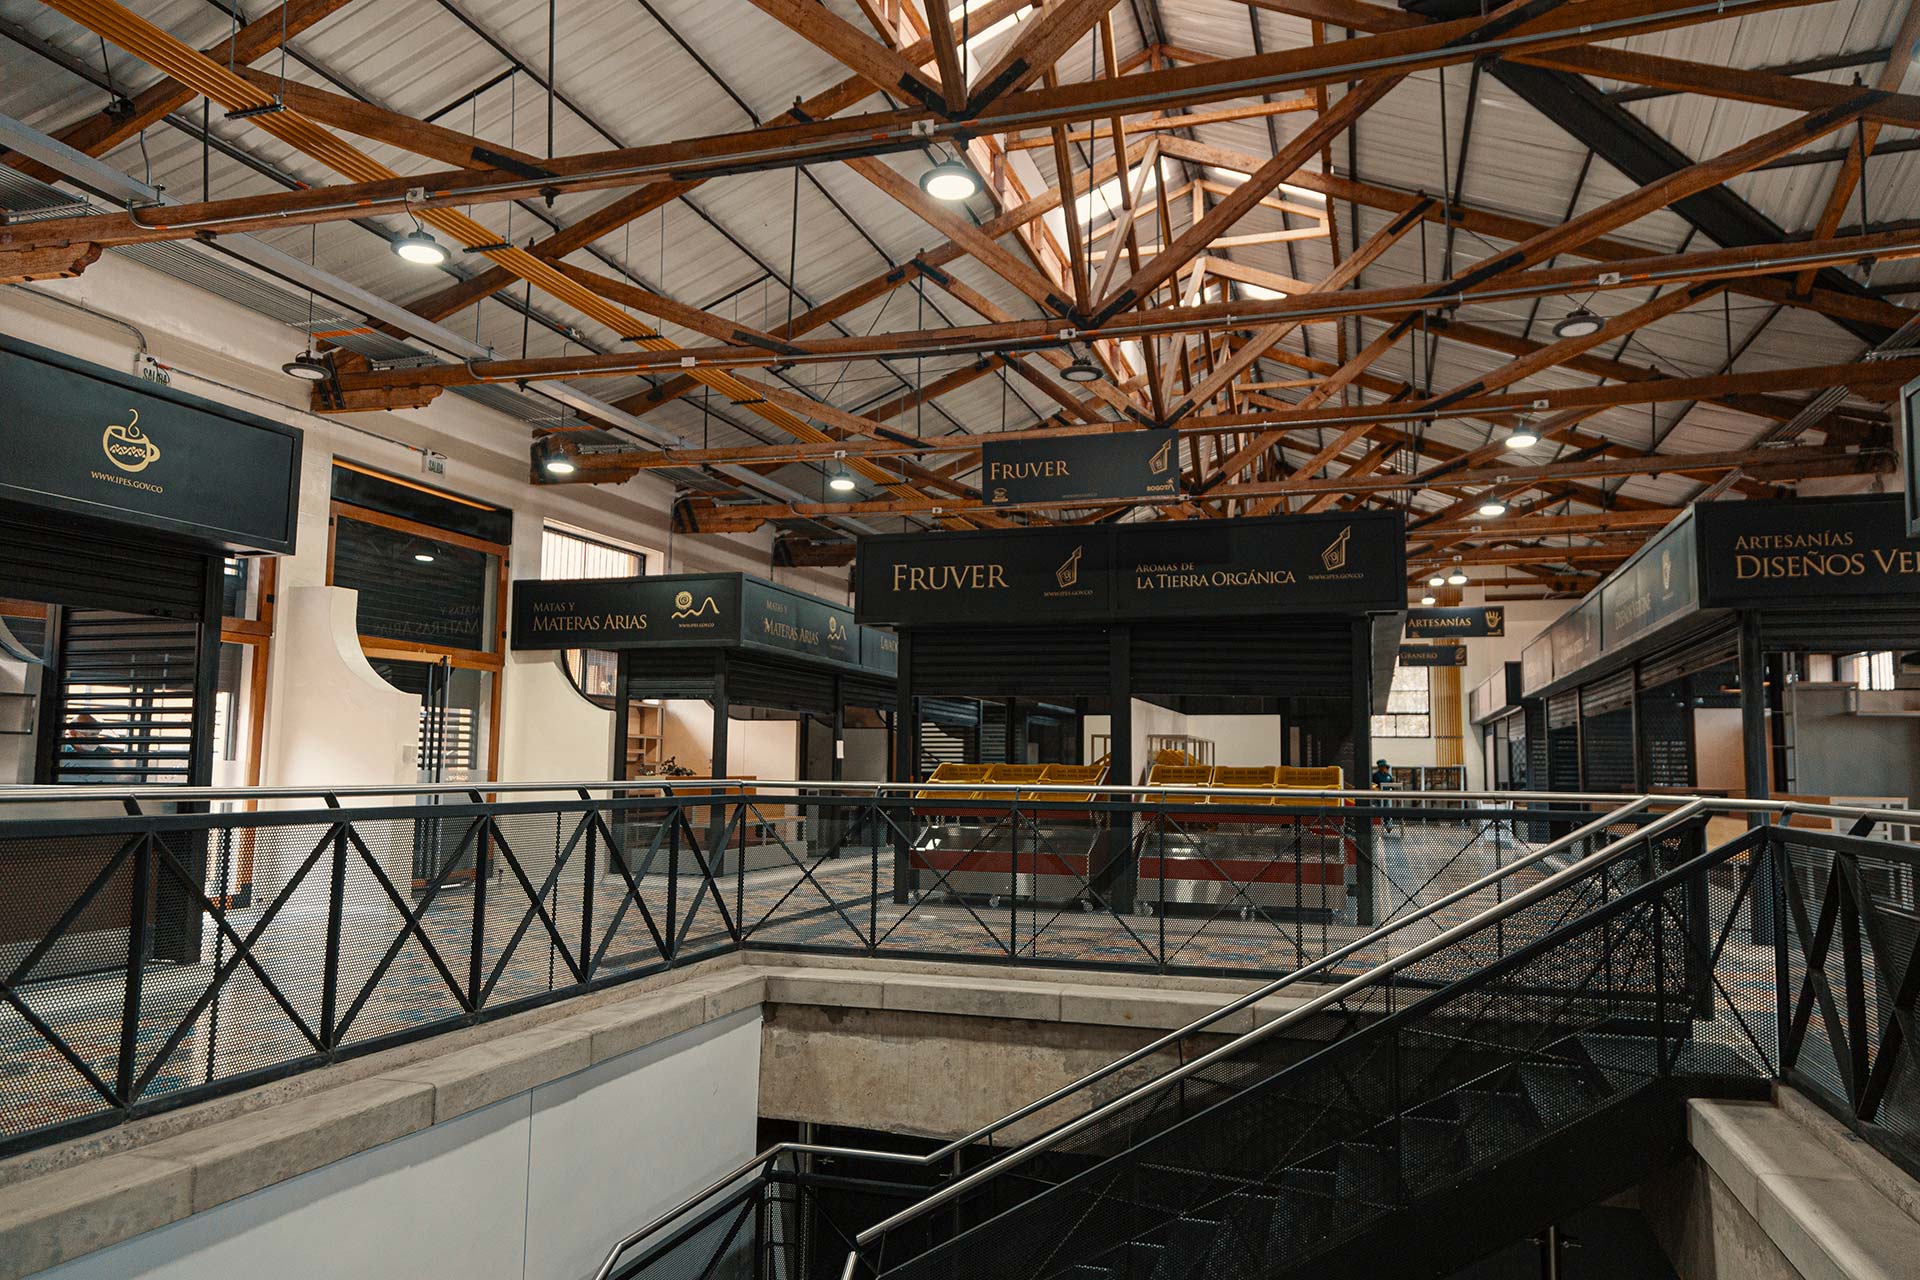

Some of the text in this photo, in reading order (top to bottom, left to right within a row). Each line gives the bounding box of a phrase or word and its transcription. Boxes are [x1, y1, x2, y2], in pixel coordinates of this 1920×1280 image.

[990, 460, 1070, 481] FRUVER
[90, 470, 164, 494] WWW.IPES.GOV.CO
[1735, 530, 1854, 550] ARTESANÍAS
[1136, 562, 1195, 573] AROMAS DE
[1735, 548, 1920, 579] DISEÑOS VE
[893, 564, 1010, 592] FRUVER
[1136, 569, 1296, 589] LA TIERRA ORGÁNICA
[533, 602, 576, 612] MATAS Y
[533, 613, 648, 631] MATERAS ARIAS
[762, 617, 799, 641] MATERAS
[1408, 616, 1472, 628] ARTESANÍAS
